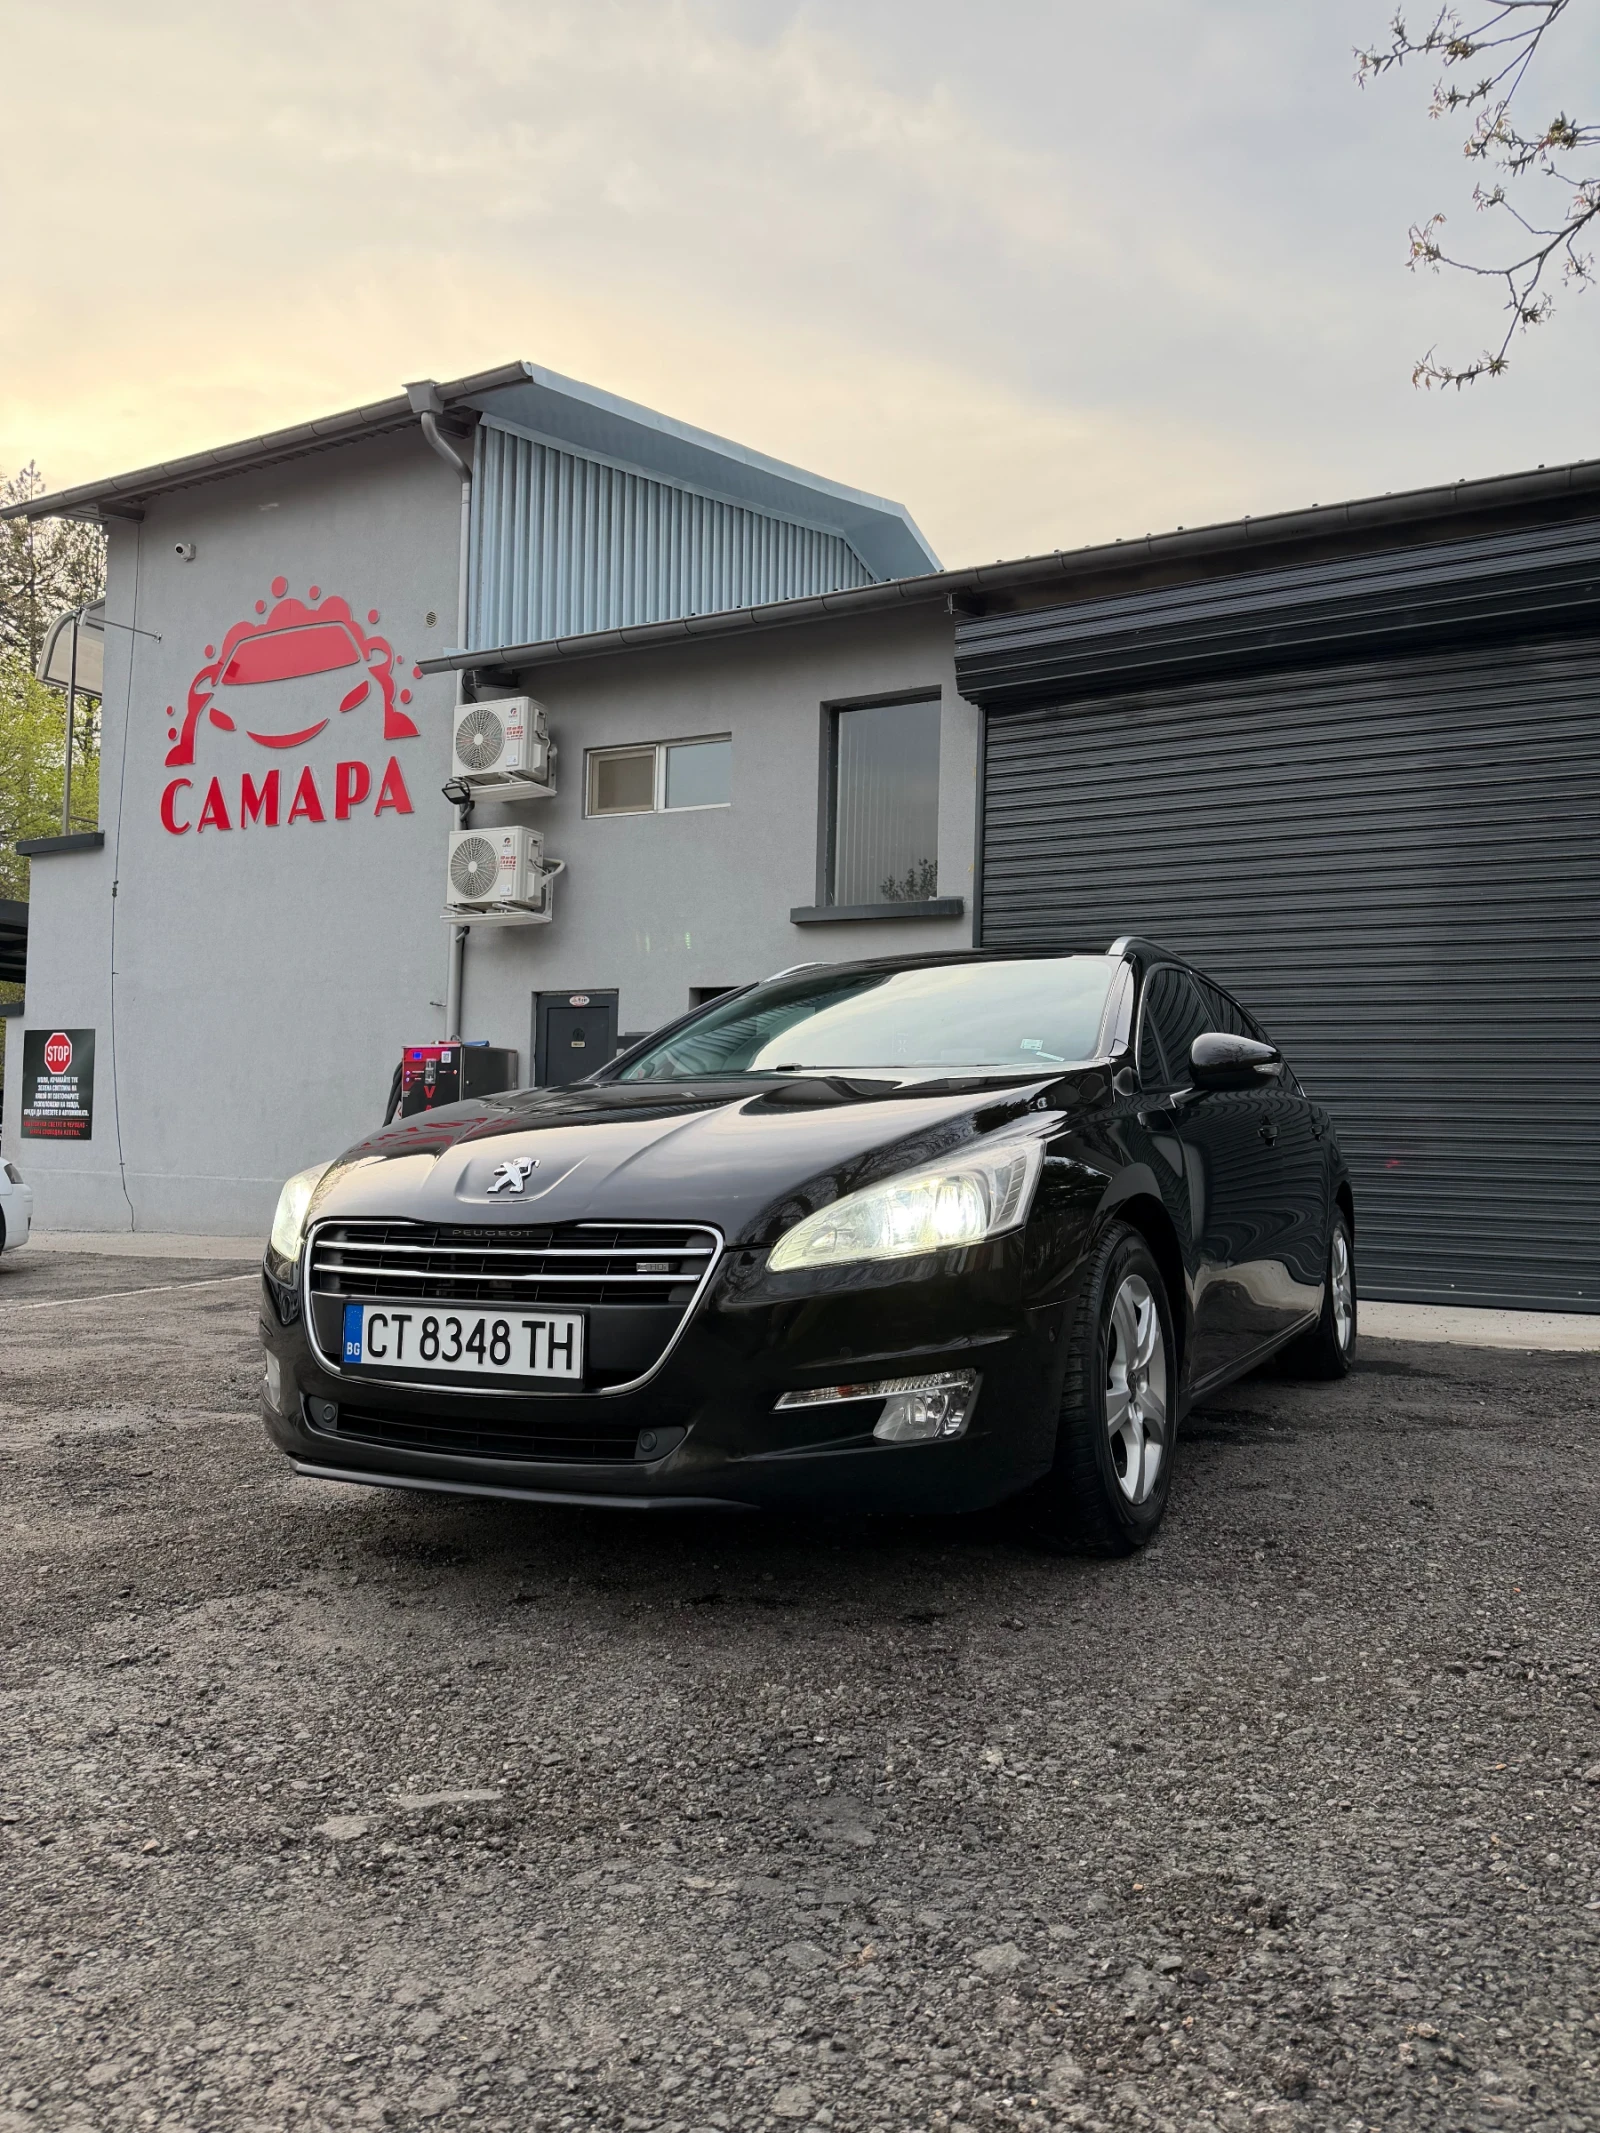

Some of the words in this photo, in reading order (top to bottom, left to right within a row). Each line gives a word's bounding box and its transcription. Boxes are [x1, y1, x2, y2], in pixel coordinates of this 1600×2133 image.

[160, 756, 415, 835] САМАРА
[47, 1045, 70, 1062] STOP
[452, 1229, 534, 1237] PEUGEOT
[346, 1342, 360, 1356] BG
[367, 1313, 412, 1360] CT
[419, 1316, 511, 1366] 8348
[522, 1321, 574, 1371] TH
